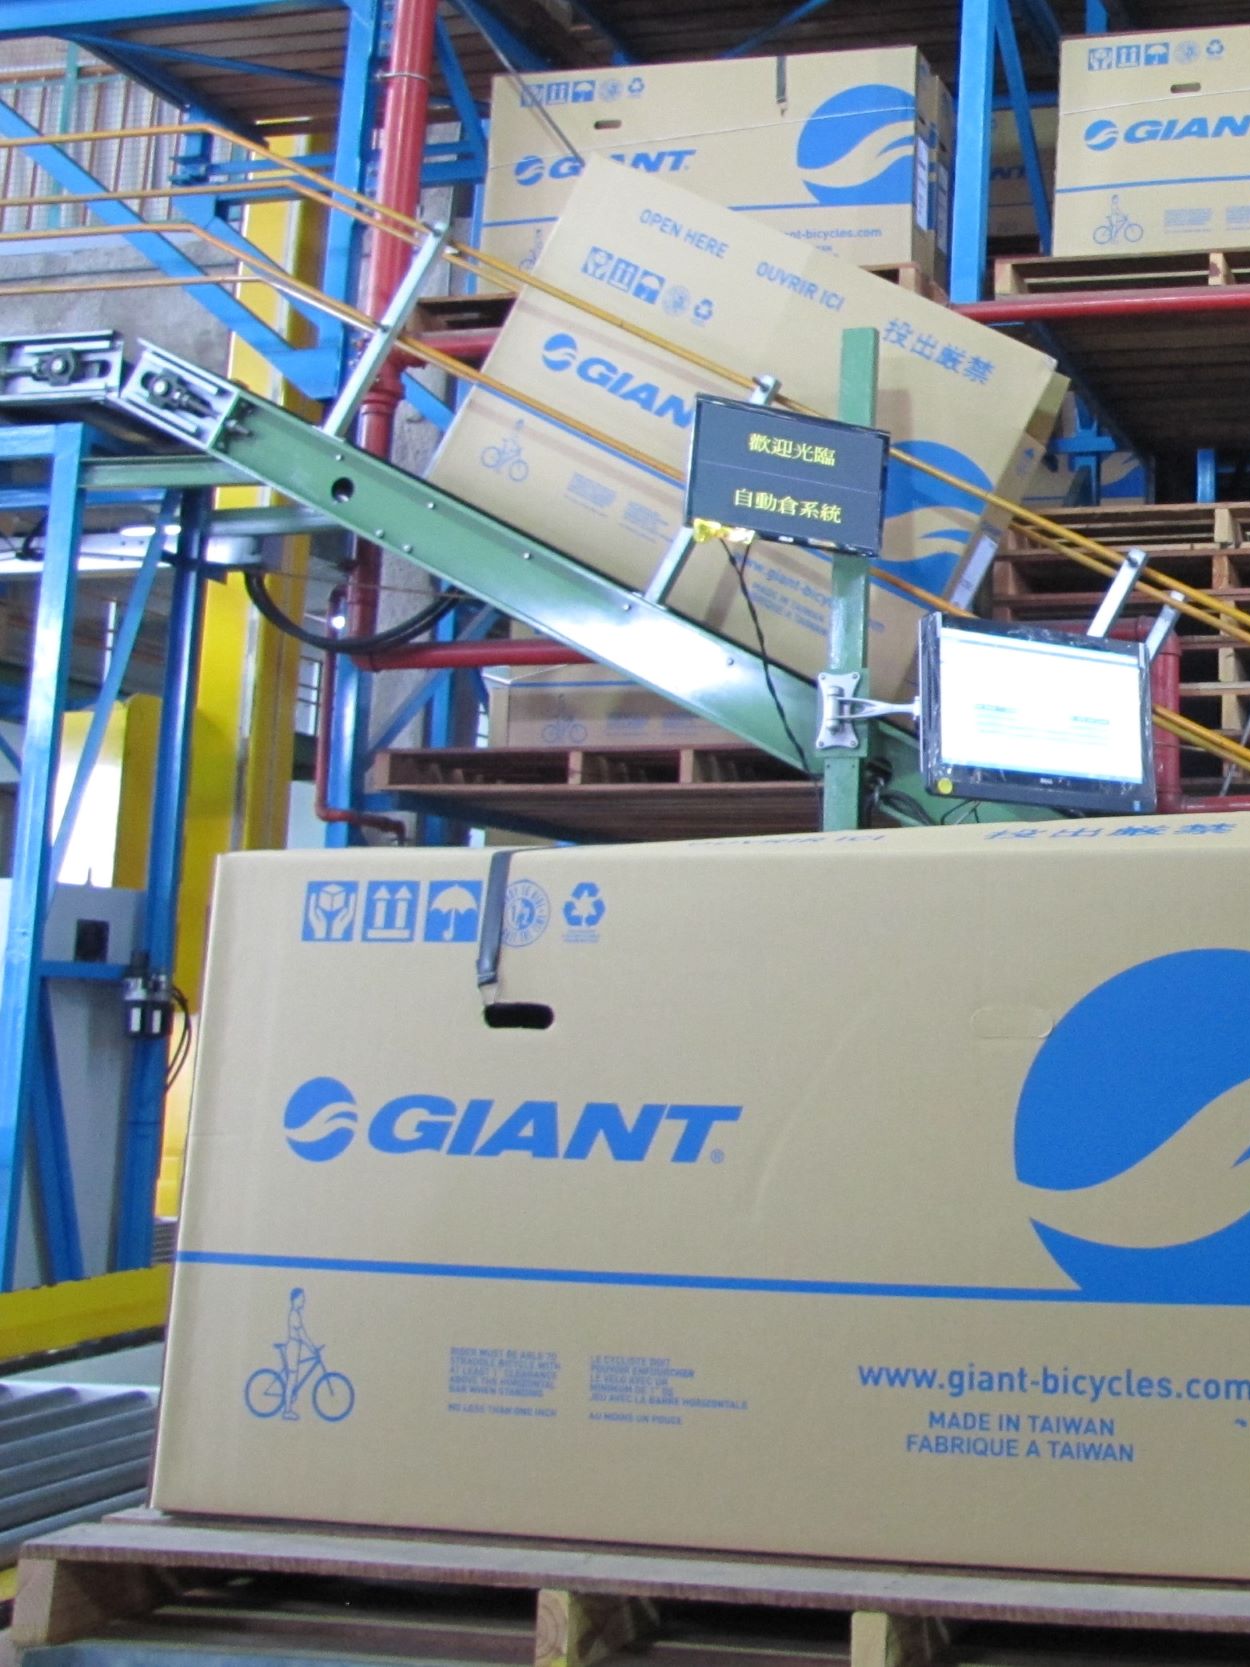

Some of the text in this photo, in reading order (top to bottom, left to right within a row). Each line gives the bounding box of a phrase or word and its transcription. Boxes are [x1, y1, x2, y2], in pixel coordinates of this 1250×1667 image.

[549, 149, 697, 181] GNT
[639, 209, 729, 259] OPEN HERE
[756, 261, 845, 312] OUVRIR ICI
[576, 357, 695, 428] GIAN
[749, 433, 836, 467] 歡迎光臨
[734, 488, 842, 524] 自動倉系統
[367, 1093, 743, 1163] GIANT
[928, 1411, 1115, 1437] MADE IN TAIWAN
[906, 1434, 1134, 1463] FABRIQUE A TAIWAN
